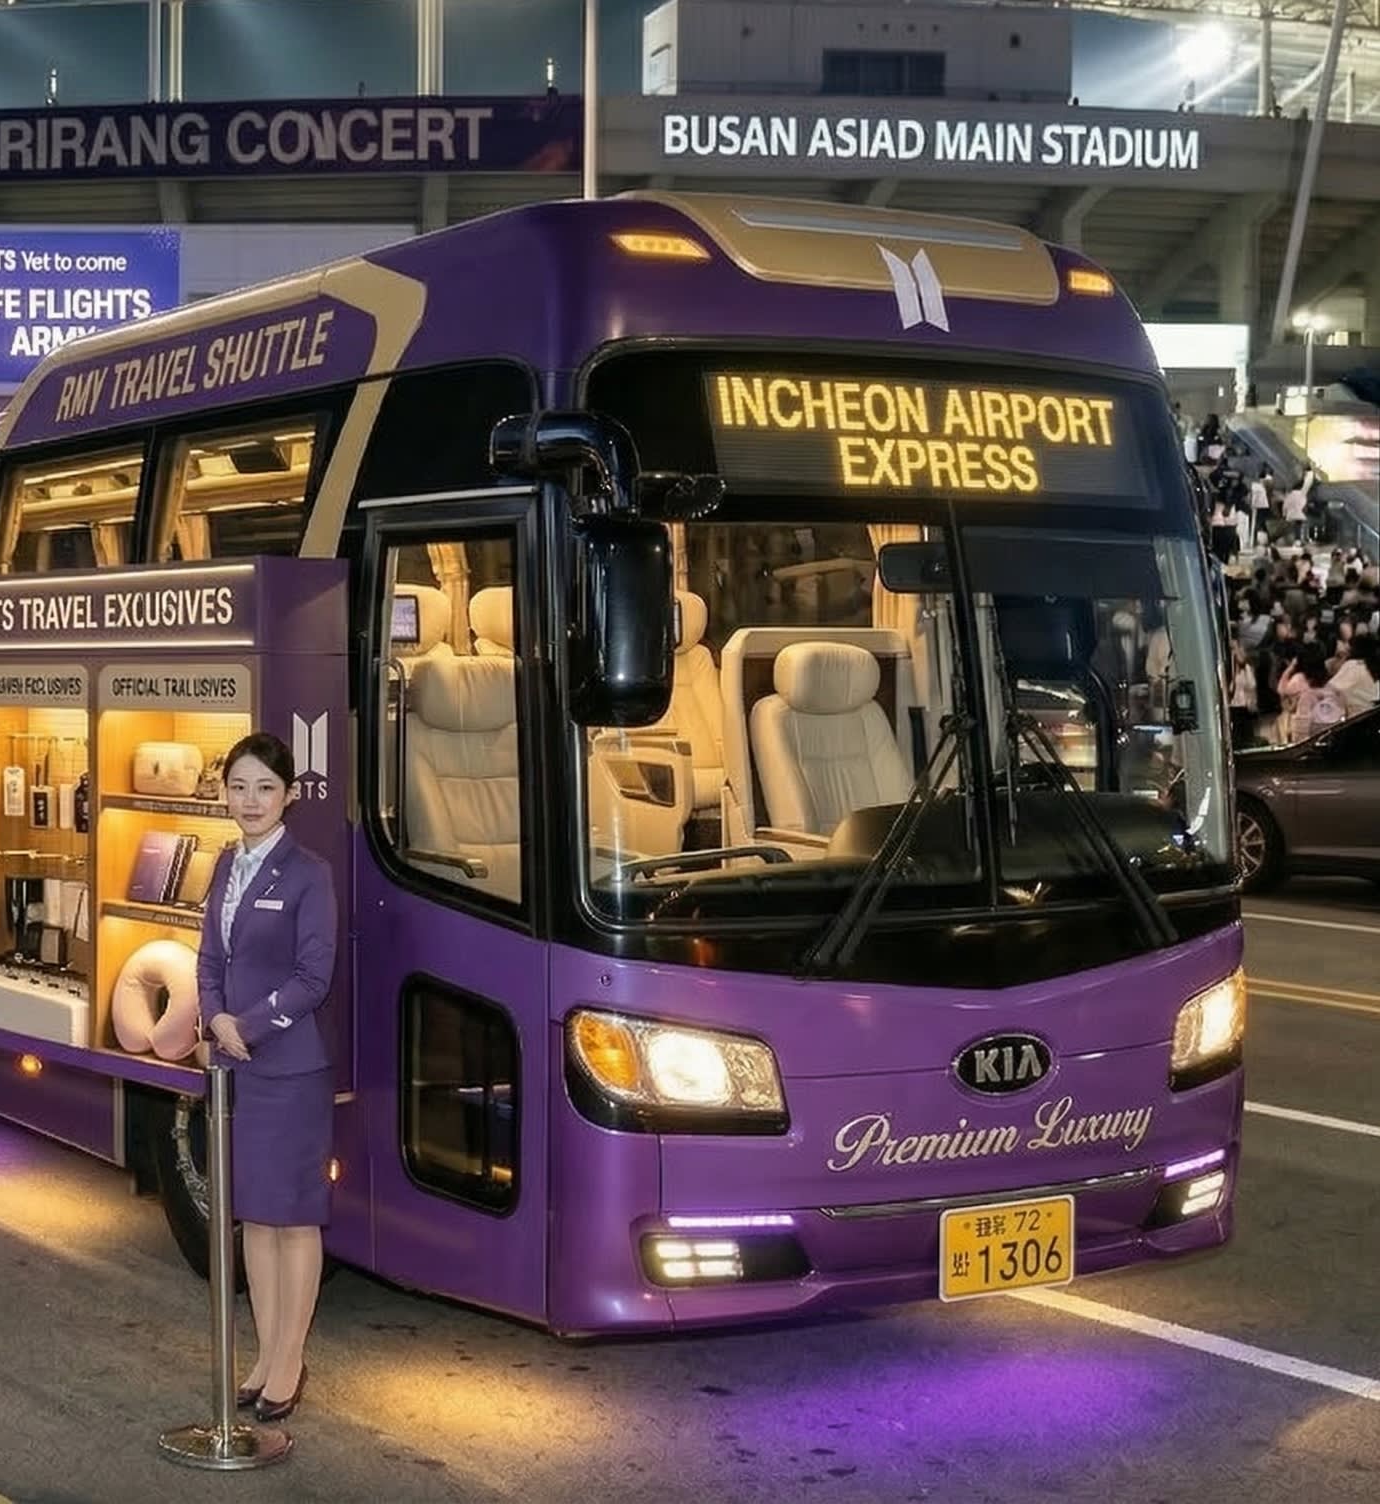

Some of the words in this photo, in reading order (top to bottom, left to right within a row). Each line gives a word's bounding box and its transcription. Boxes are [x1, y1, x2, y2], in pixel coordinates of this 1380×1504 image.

[227, 107, 493, 165] CONCERT
[663, 115, 797, 157] BUSAN
[807, 117, 926, 160] ASIAD
[935, 121, 1033, 163] MAIN
[1041, 124, 1199, 169] STADIUM
[21, 250, 51, 272] Yet
[54, 253, 72, 272] to
[76, 256, 127, 272] come
[29, 288, 152, 320] FLIGHTS
[55, 366, 108, 423] RMY
[110, 345, 197, 410] TRAVEL
[203, 311, 334, 389] SHUTTLE
[716, 375, 929, 434] INCHEON
[943, 389, 1114, 446] AIRPORT
[838, 437, 1039, 492] EXPRESS
[20, 596, 98, 630] TRAVEL
[974, 1044, 1042, 1083] KIA
[827, 1111, 1019, 1172] Premium
[1027, 1096, 1153, 1151] Luxury
[1014, 1208, 1041, 1232] 72
[978, 1235, 1063, 1284] 1306
